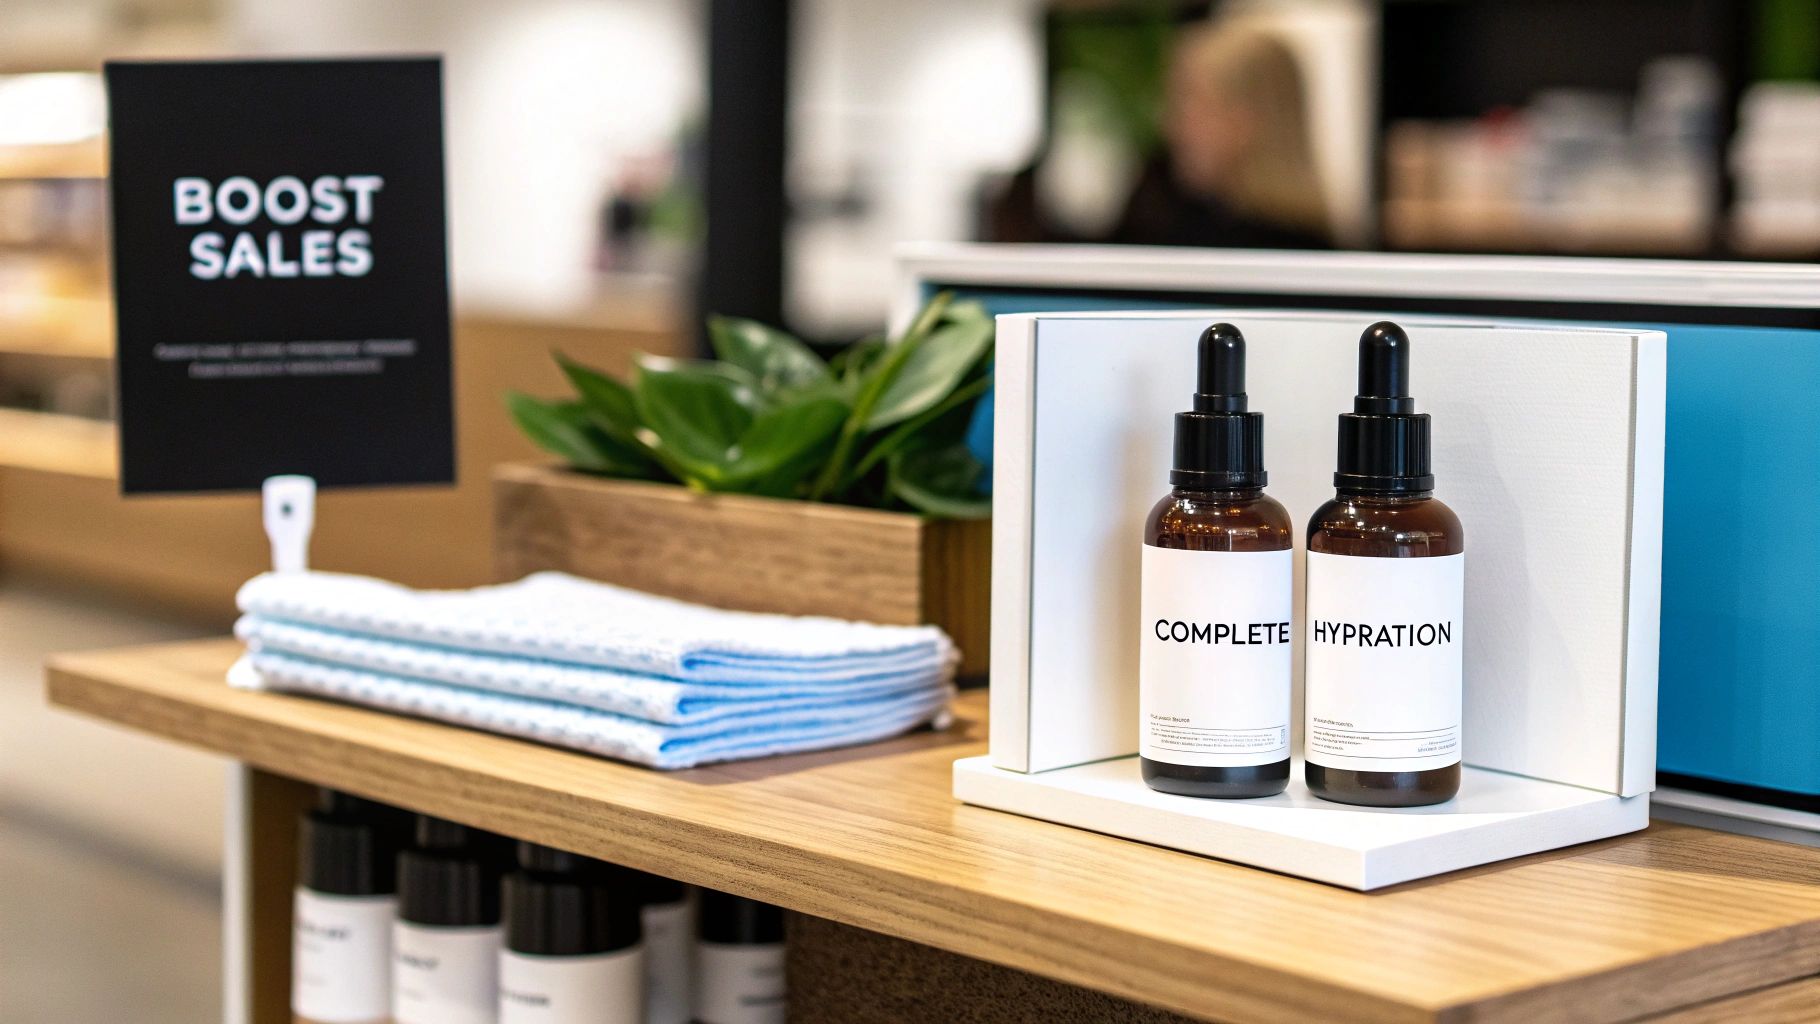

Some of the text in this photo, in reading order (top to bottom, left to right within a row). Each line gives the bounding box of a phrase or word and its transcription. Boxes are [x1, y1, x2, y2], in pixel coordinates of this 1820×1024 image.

[174, 175, 383, 225] BOOST
[189, 230, 373, 279] SALES
[1155, 618, 1290, 645] COMPLETE
[1314, 619, 1451, 647] HYPRATION
